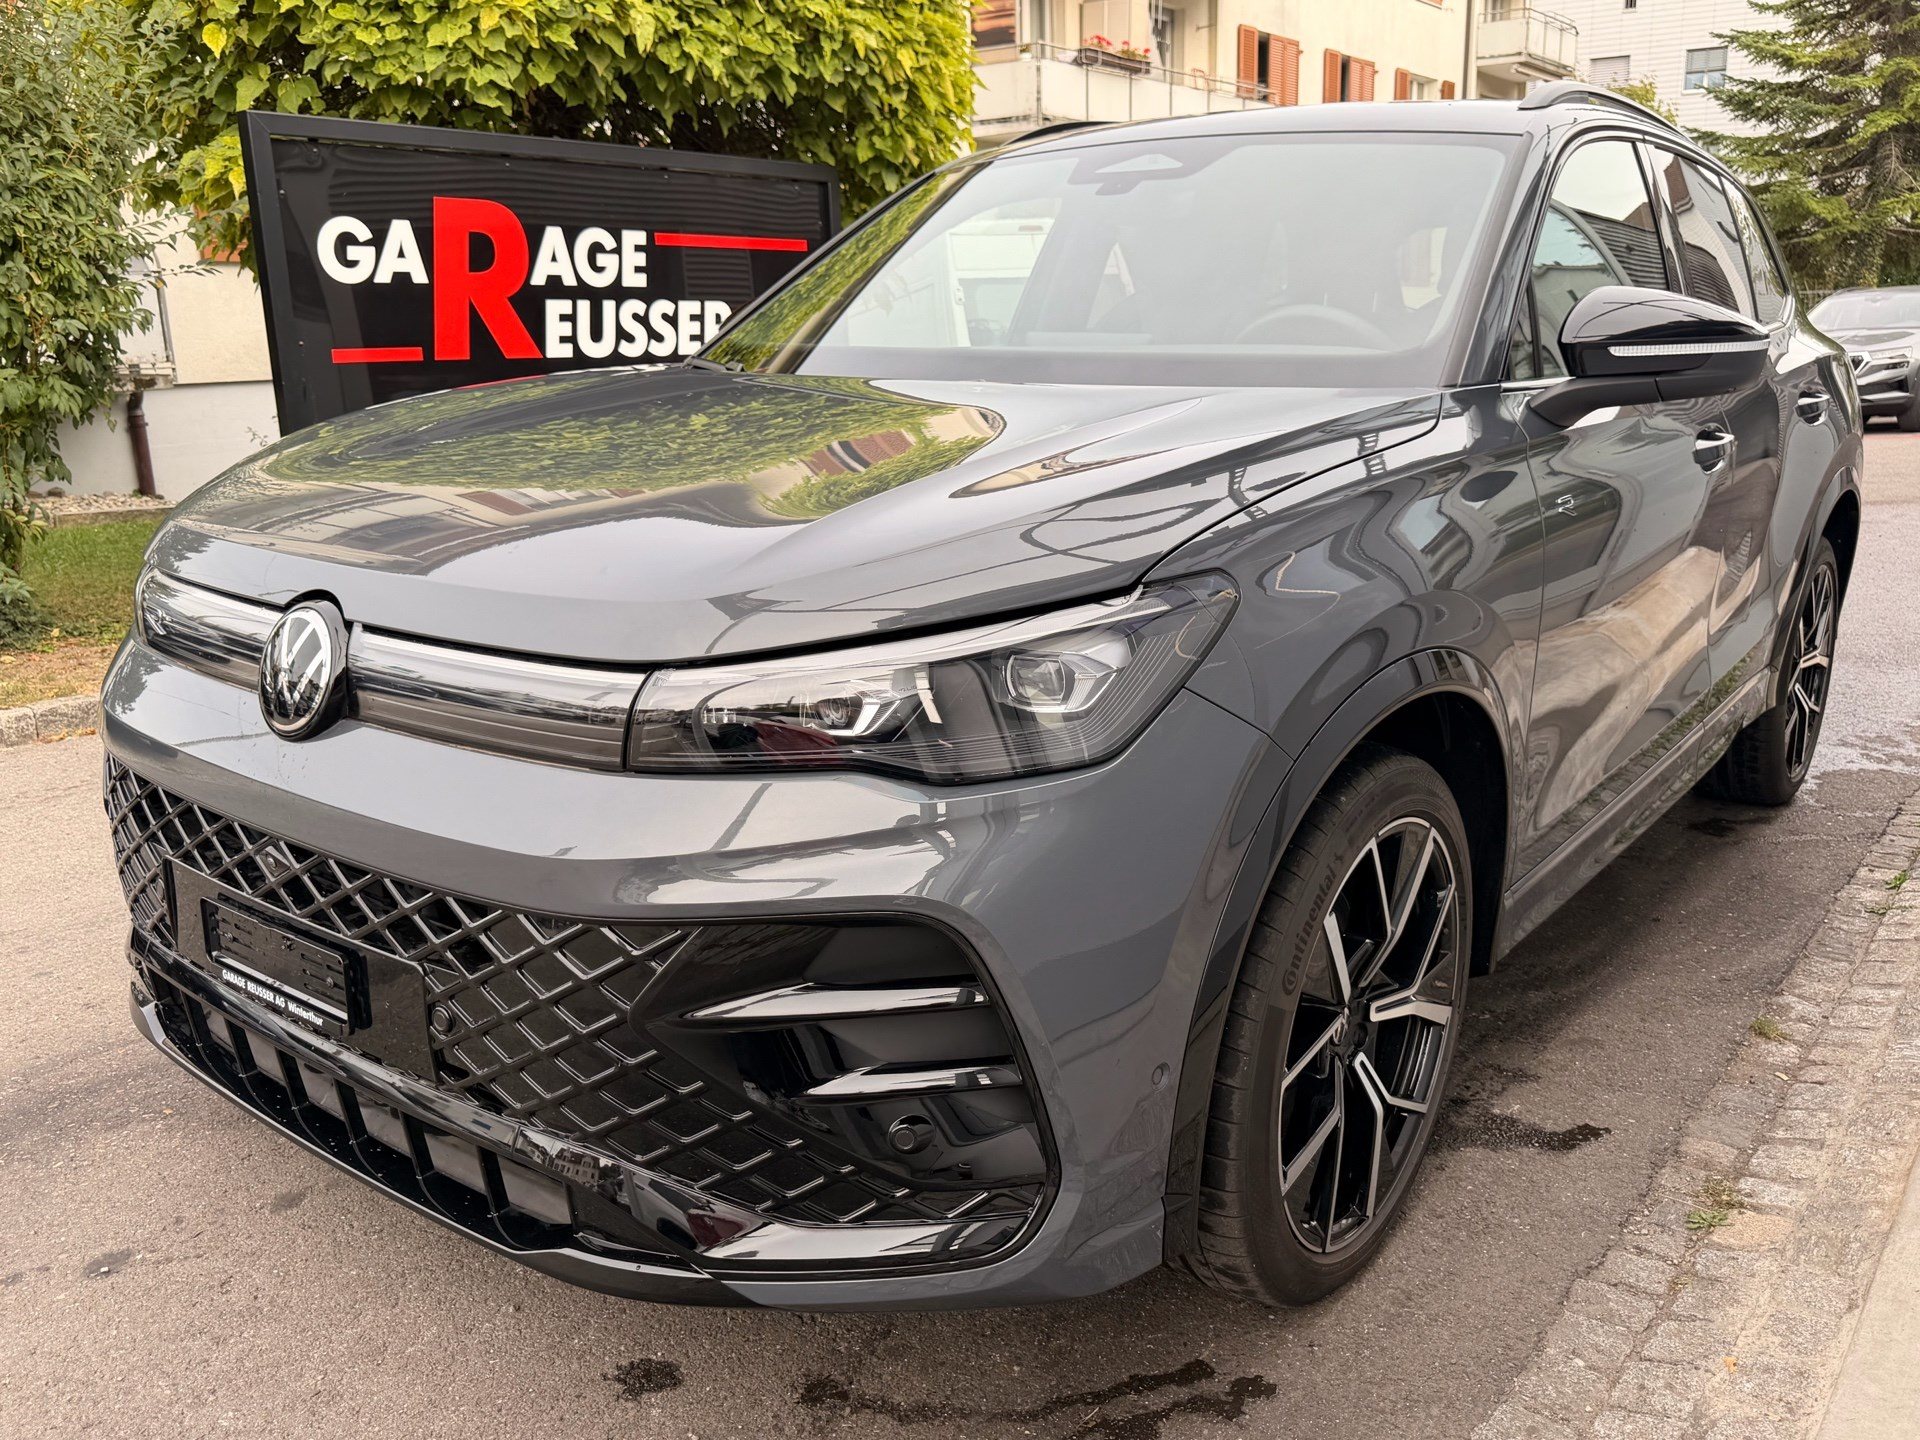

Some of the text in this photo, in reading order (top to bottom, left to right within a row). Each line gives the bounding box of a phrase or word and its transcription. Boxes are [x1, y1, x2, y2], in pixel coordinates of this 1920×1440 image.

[316, 196, 648, 361] GARAGE
[1281, 865, 1338, 996] Continental
[222, 969, 324, 1026] GARAGE REUSSER AG Winterthur
